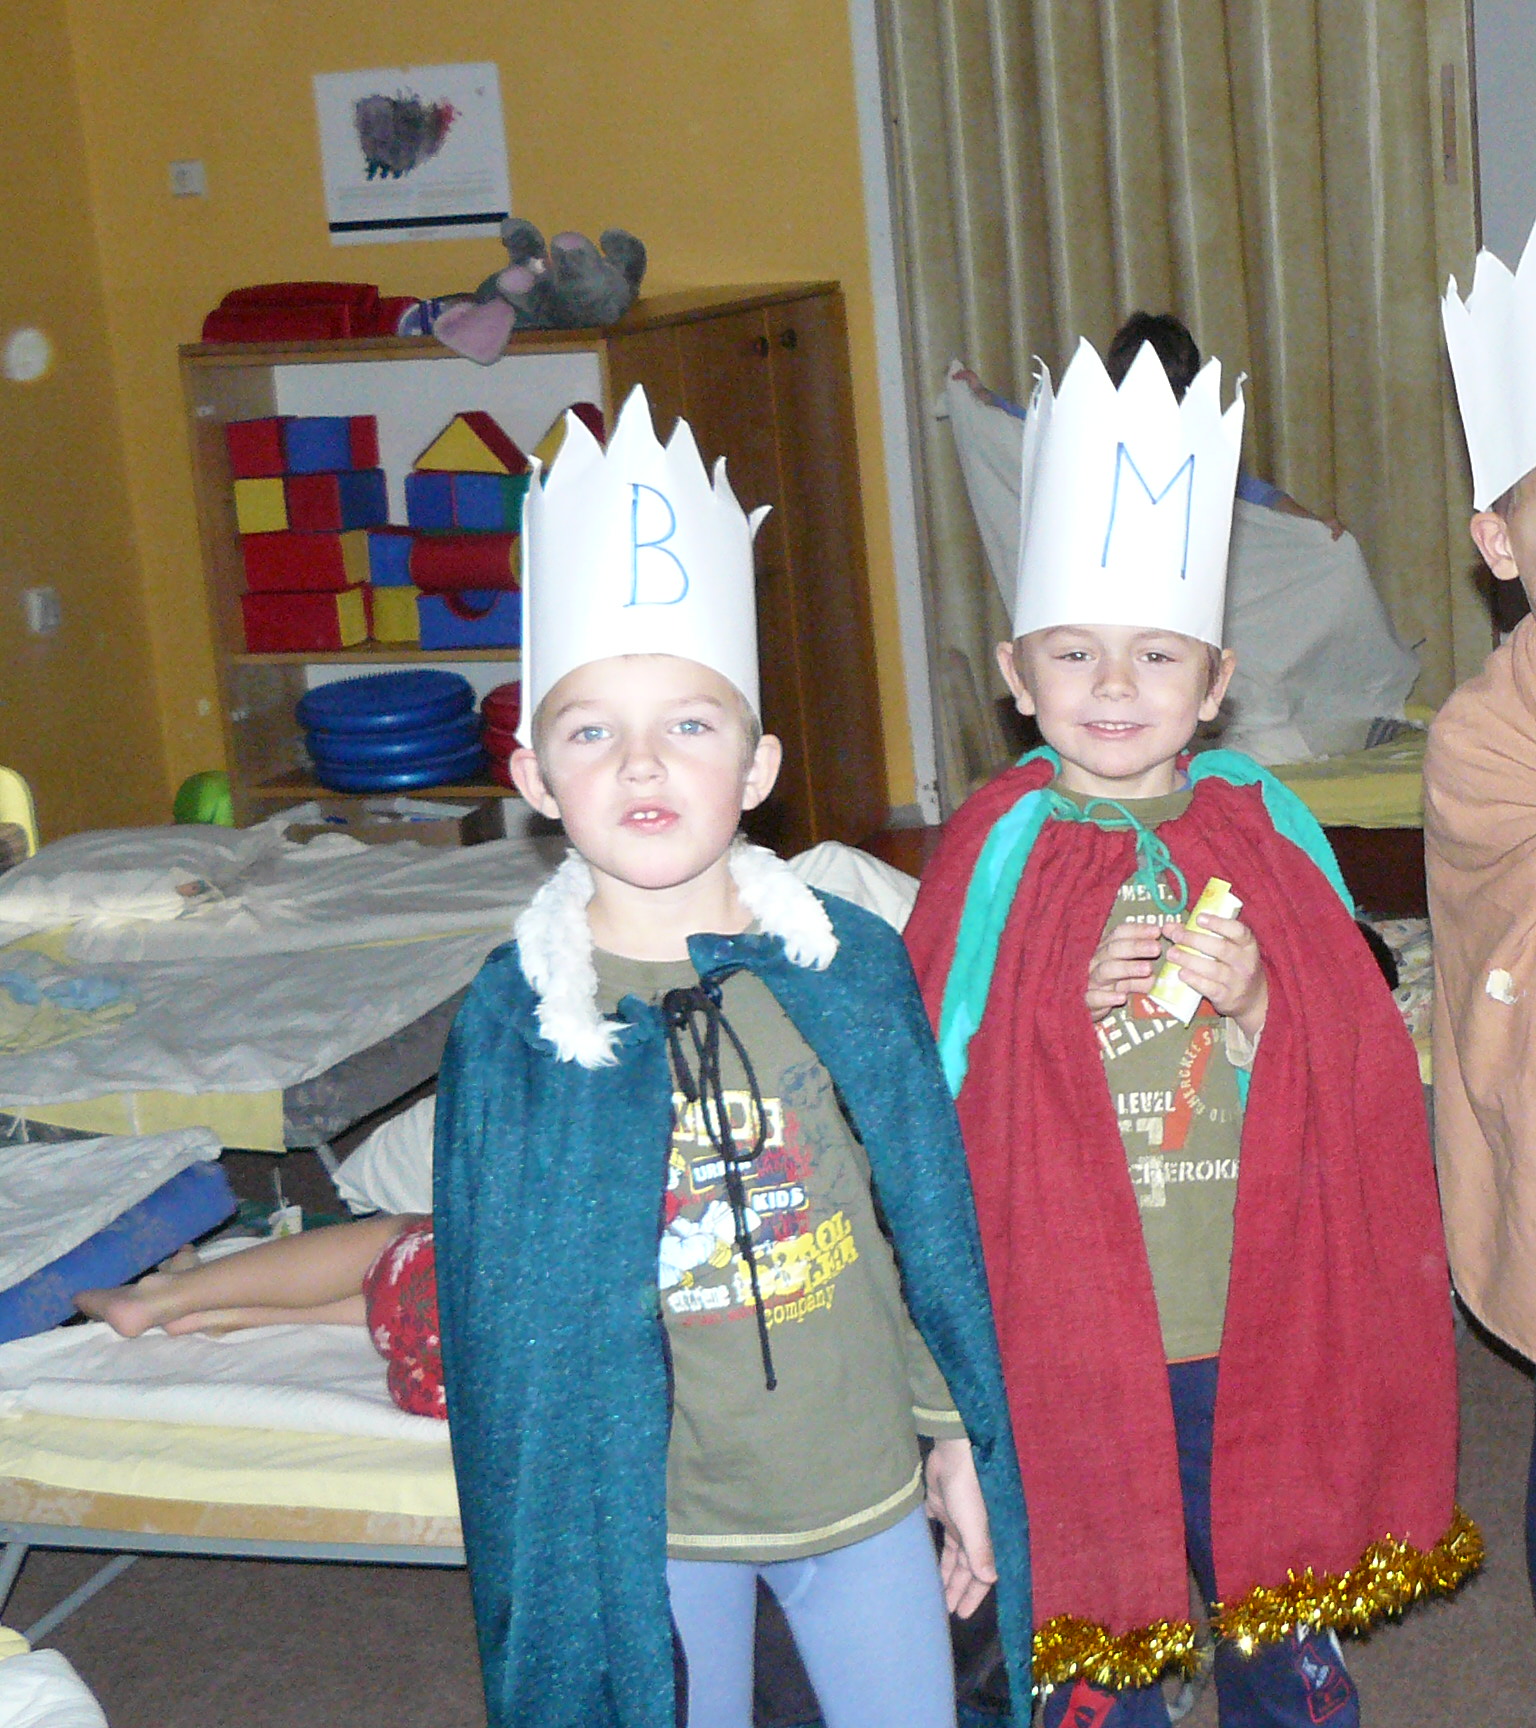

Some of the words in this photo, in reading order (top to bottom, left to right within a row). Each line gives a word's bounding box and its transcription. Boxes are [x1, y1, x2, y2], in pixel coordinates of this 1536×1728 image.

[1101, 441, 1195, 580] M
[623, 482, 689, 608] B
[1117, 1090, 1177, 1115] LEVEL
[752, 1187, 804, 1212] KIDS
[765, 1284, 836, 1331] company
